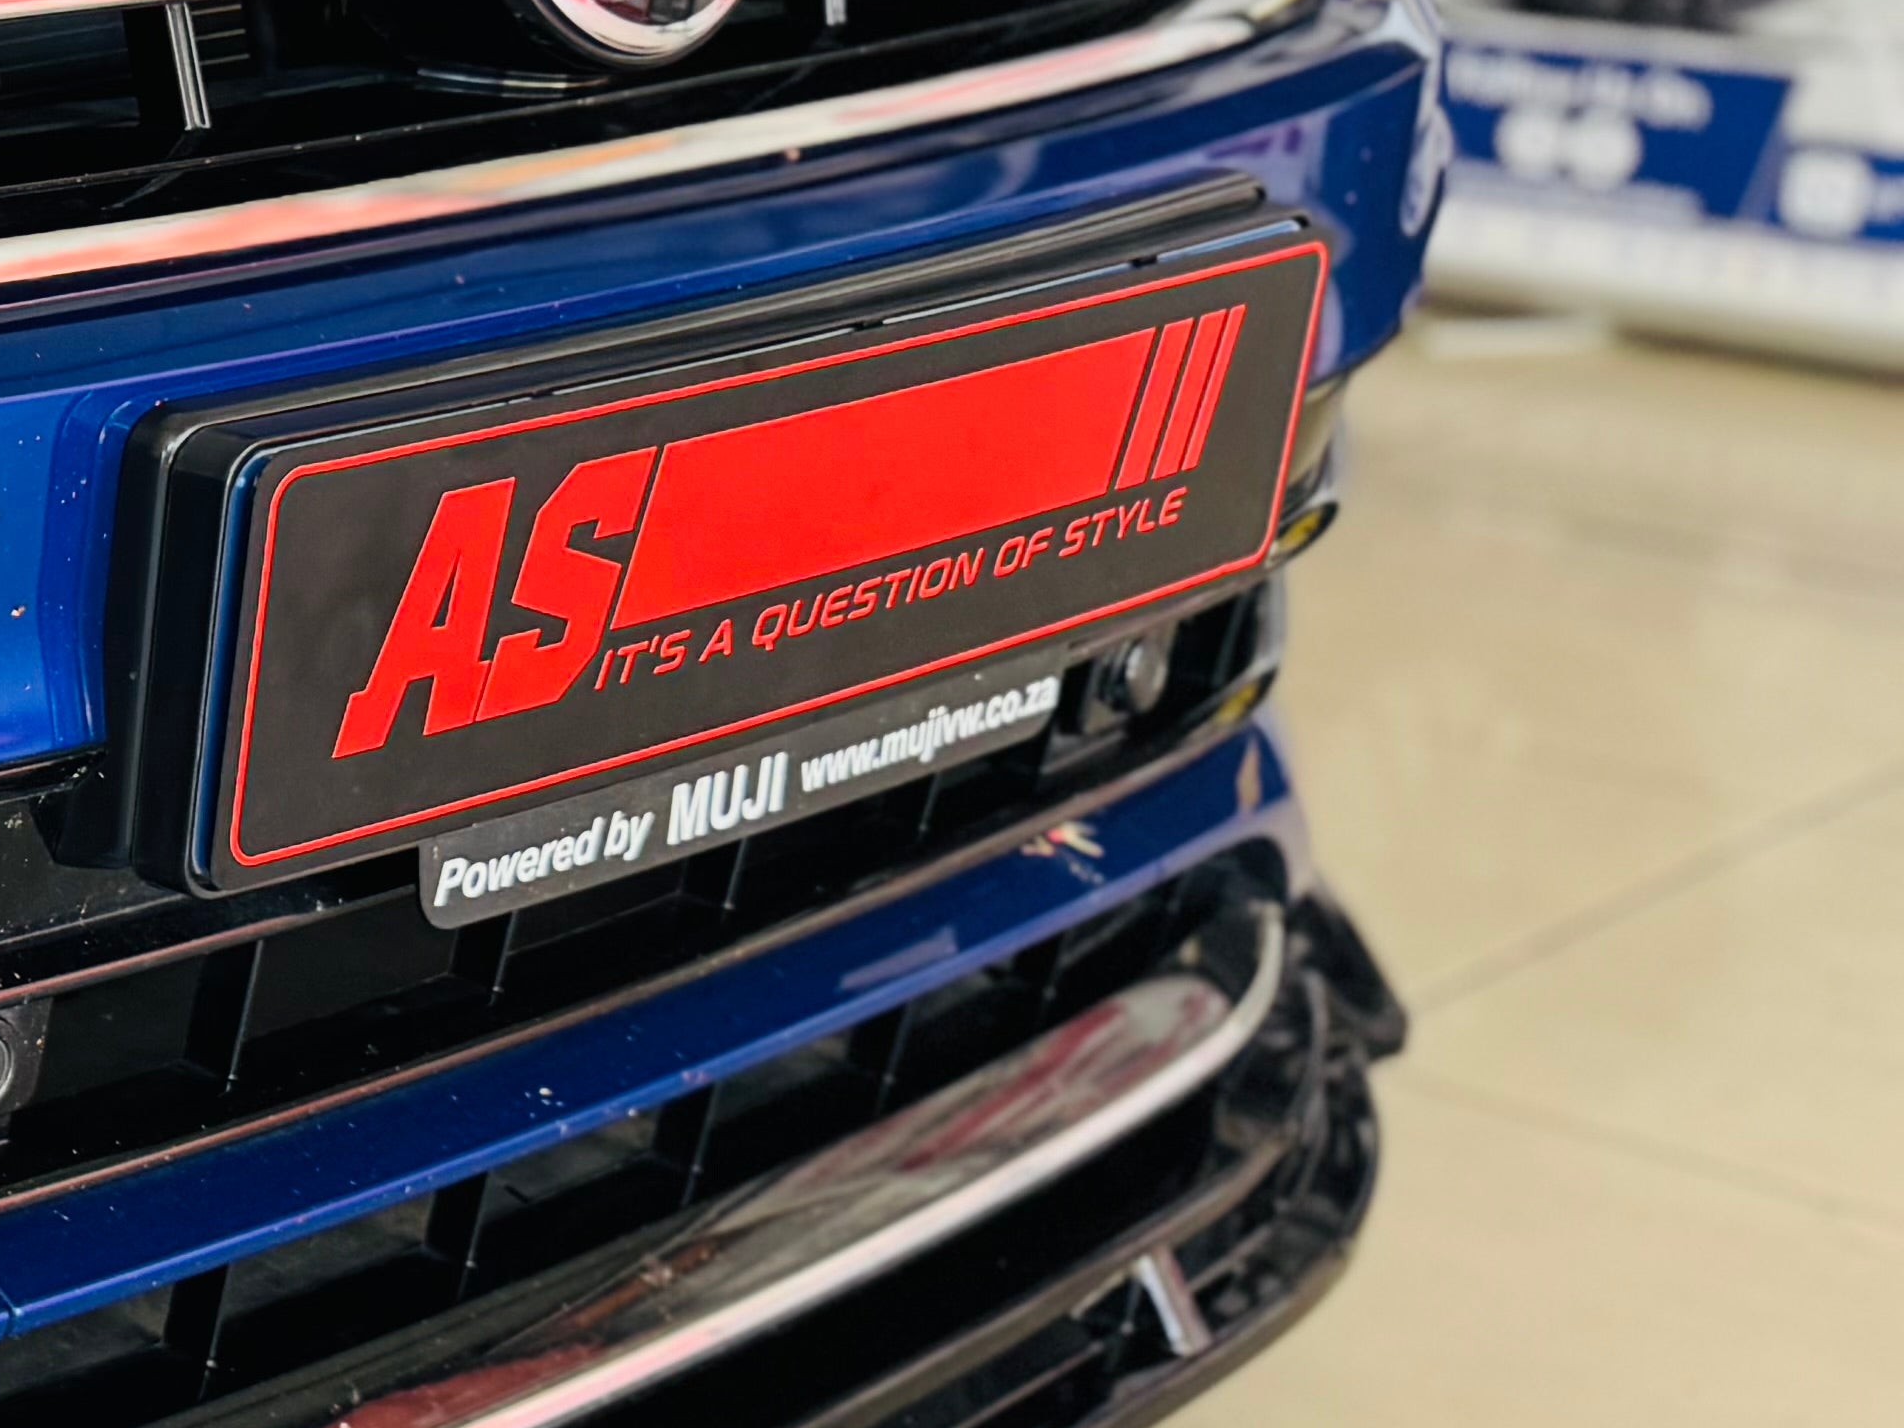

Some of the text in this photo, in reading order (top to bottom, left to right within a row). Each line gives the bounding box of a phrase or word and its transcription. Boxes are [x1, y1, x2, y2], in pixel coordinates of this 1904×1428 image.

[332, 445, 658, 760] AS
[594, 485, 1190, 692] IT'S A QUESTION OF STYLE
[433, 675, 1059, 907] Powered by MUJI www.mujivw.co.za
